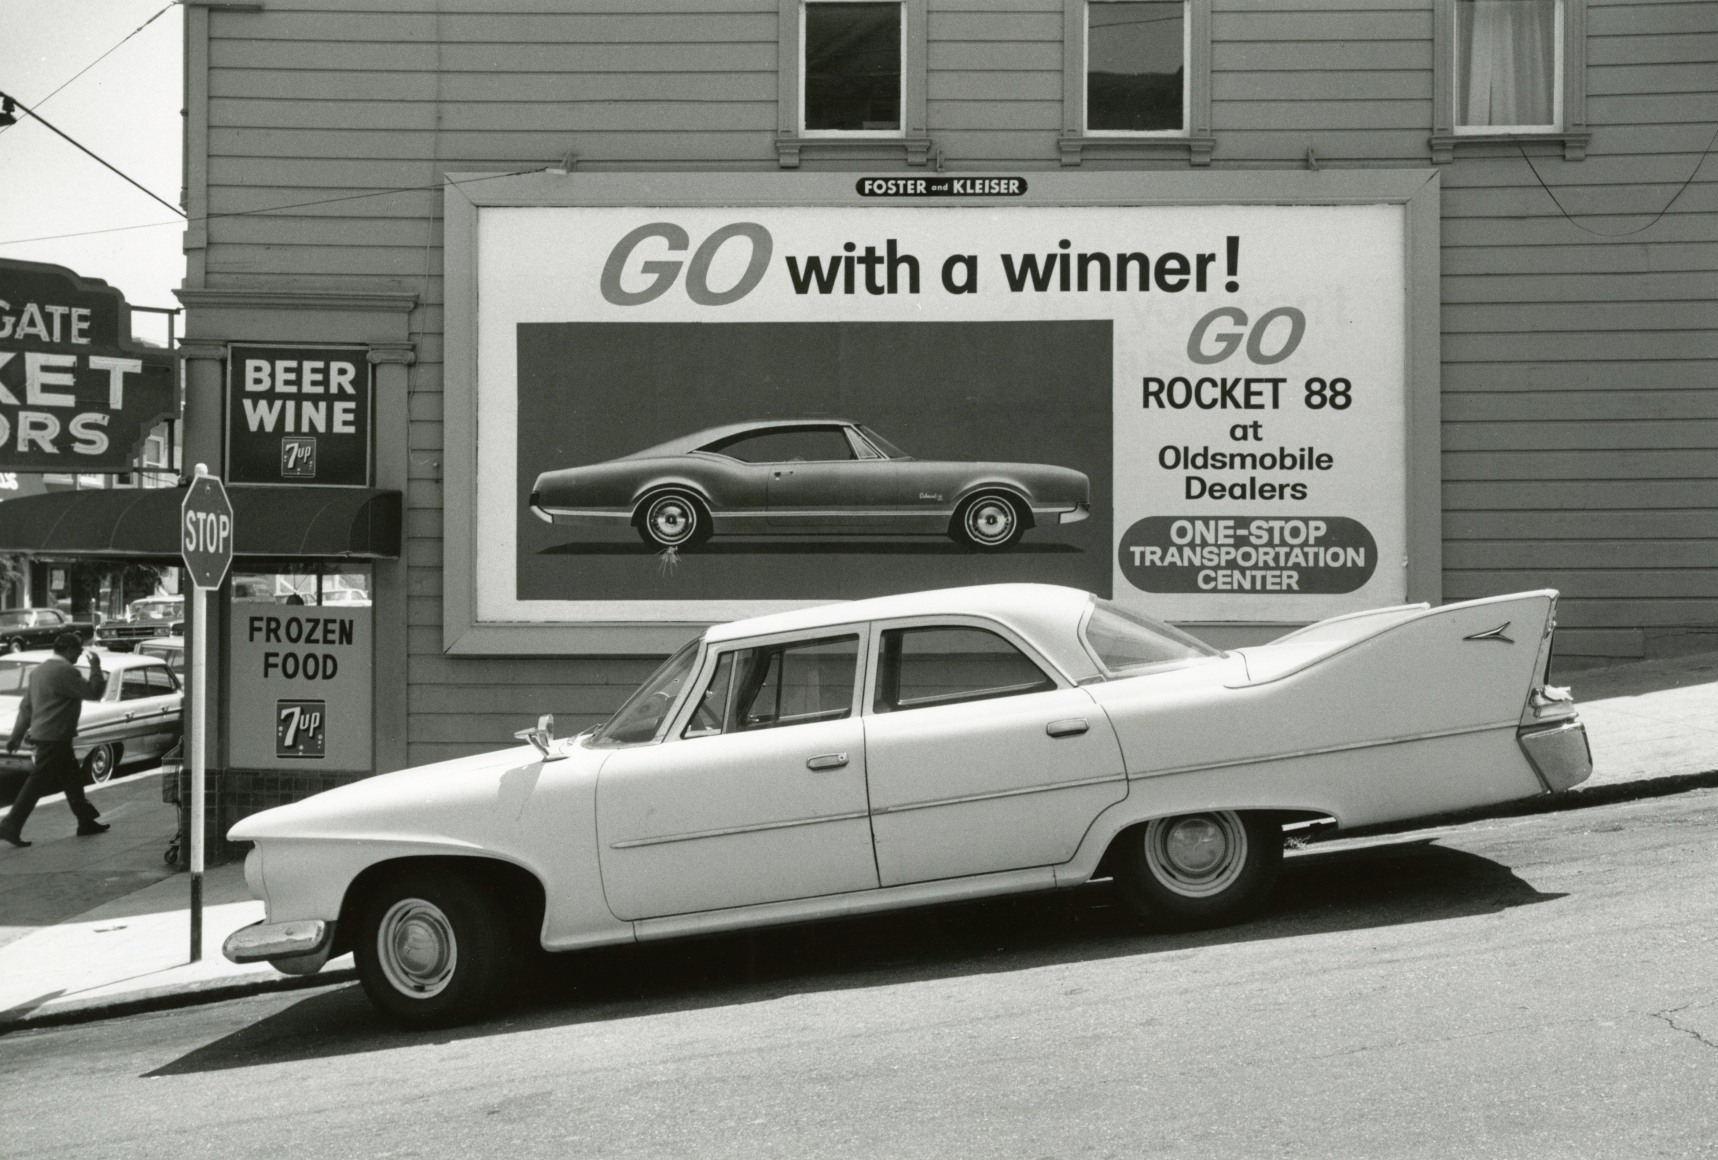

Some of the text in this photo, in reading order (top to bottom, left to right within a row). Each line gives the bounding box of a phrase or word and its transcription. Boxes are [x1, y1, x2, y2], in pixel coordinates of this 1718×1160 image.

[864, 179, 1020, 195] FOSTER and KLEISER
[599, 221, 1240, 307] GO with a winner!
[1186, 306, 1307, 366] GO
[244, 358, 356, 395] BEER
[1142, 376, 1353, 411] ROCKET 88
[242, 398, 357, 434] WINE
[1229, 420, 1264, 442] at
[0, 410, 110, 455] RS
[1158, 445, 1334, 471] Oldsmobile
[1185, 475, 1308, 501] Dealers
[185, 509, 230, 554] STOP
[1170, 519, 1327, 546] ONE-STOP
[1129, 545, 1365, 568] TRANSPORTATION
[1197, 569, 1300, 591] CENTER
[248, 616, 354, 646] FROZEN
[263, 651, 338, 681] FOOD
